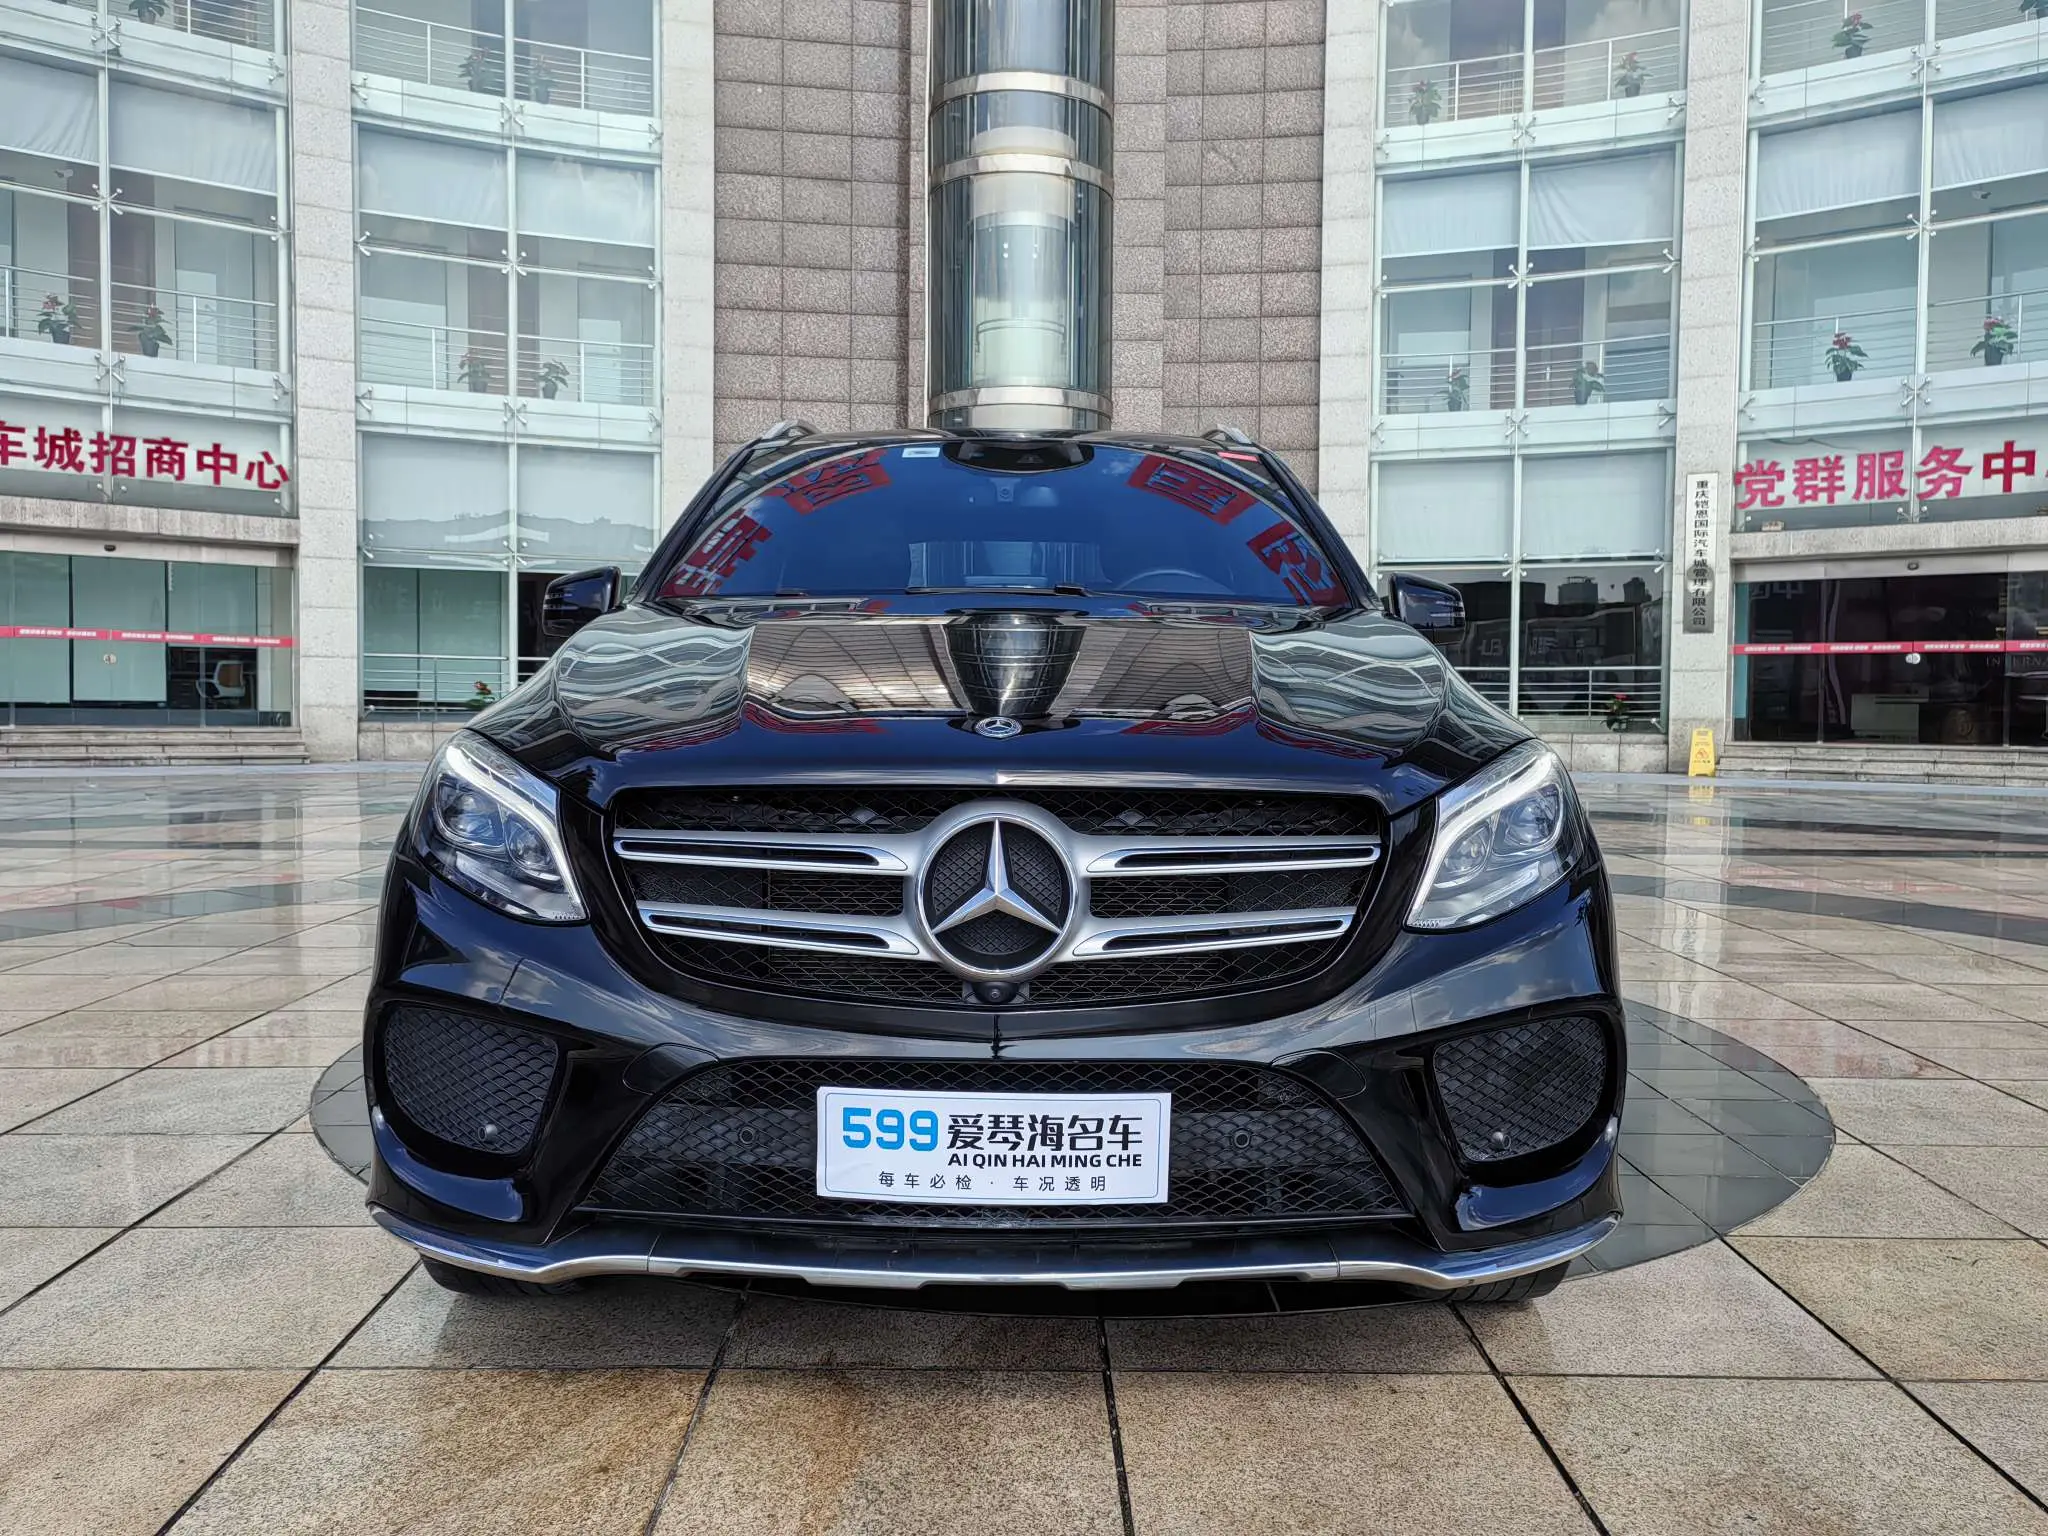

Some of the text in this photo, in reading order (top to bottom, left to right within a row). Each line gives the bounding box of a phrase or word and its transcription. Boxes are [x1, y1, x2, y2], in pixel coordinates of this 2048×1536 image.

[0, 420, 289, 490] 车城招商中心
[1733, 440, 2048, 509] 党群服务中
[842, 1106, 1143, 1153] 599 爱琴海名车
[947, 1153, 1142, 1170] AI QIN HAI MING CHE
